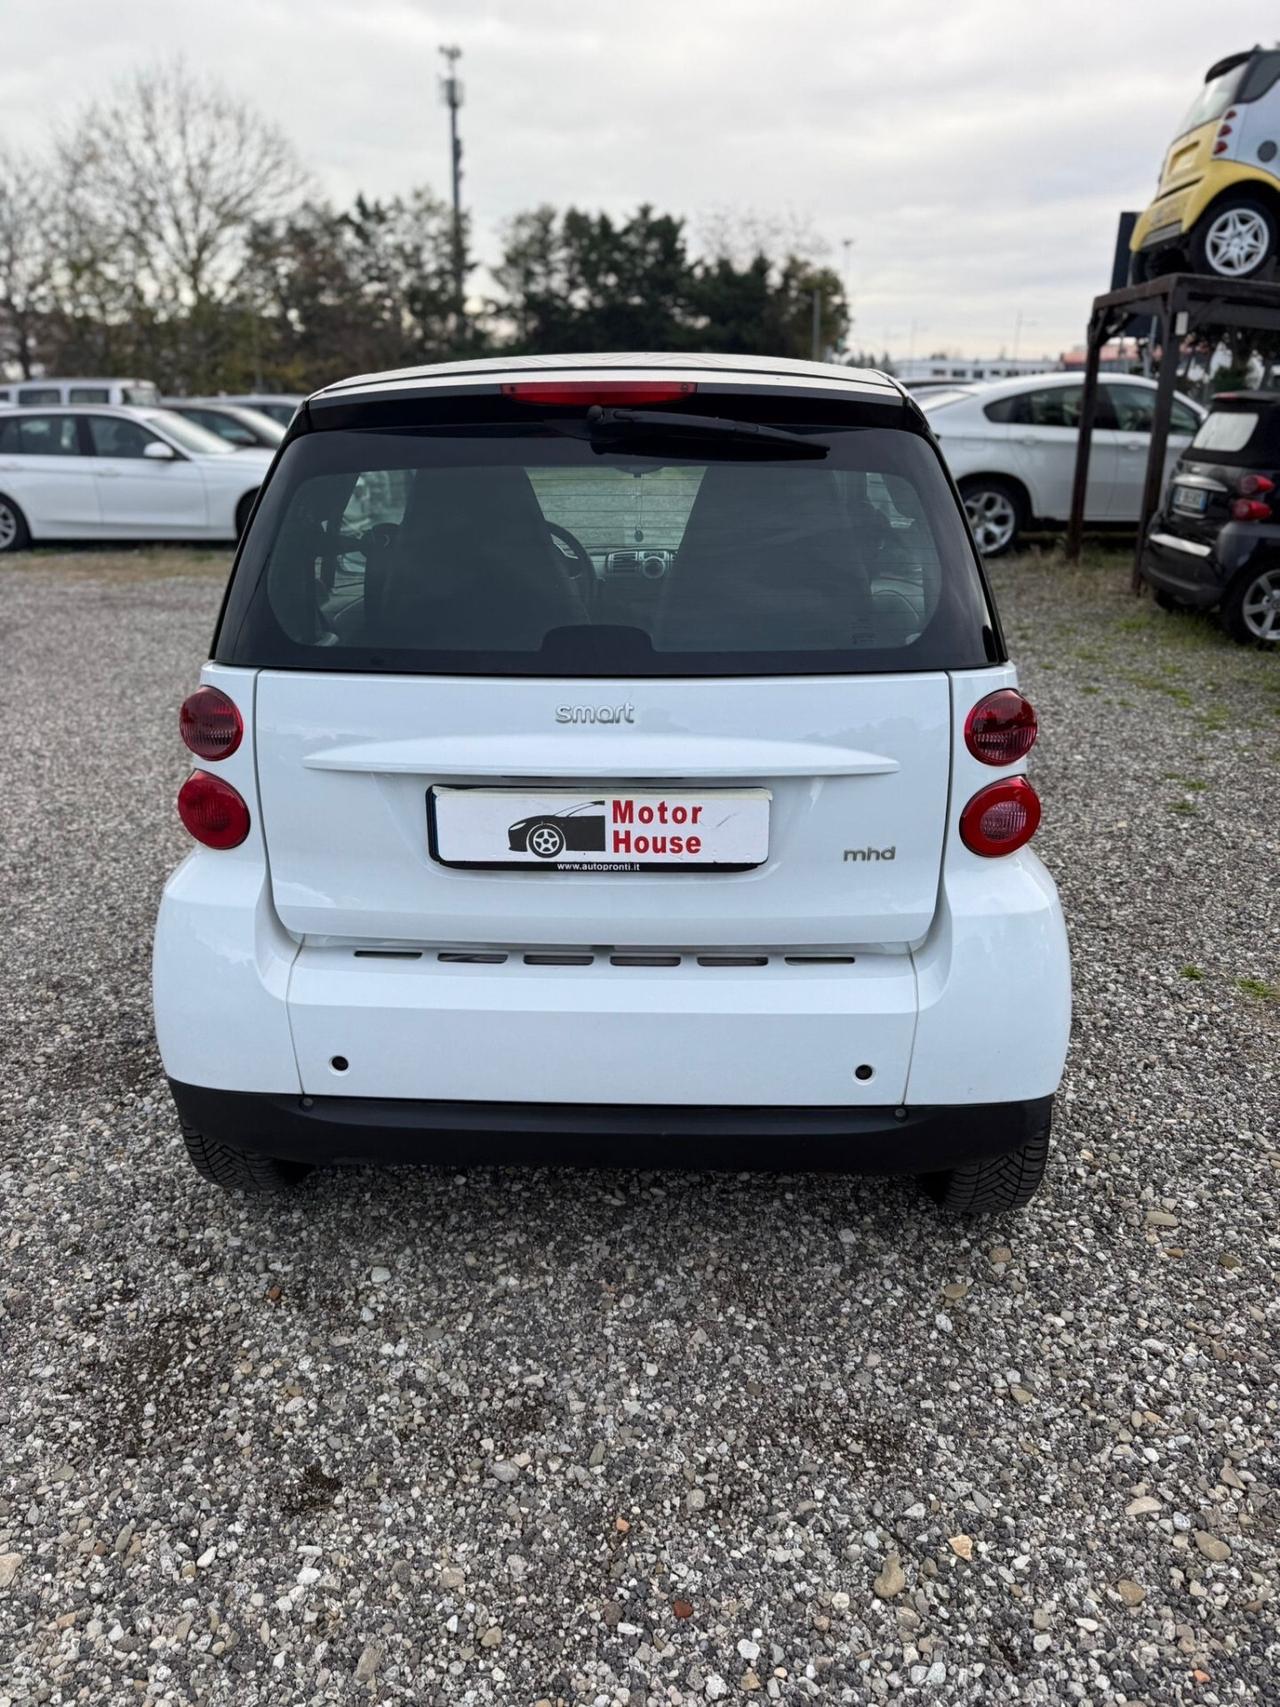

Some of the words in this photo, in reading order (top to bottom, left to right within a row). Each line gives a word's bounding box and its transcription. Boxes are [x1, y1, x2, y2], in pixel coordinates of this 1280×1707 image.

[555, 702, 635, 724] smart
[612, 799, 703, 824] Motor
[613, 830, 702, 854] House
[843, 846, 896, 862] mhd
[557, 863, 641, 871] www.autopronti.it
